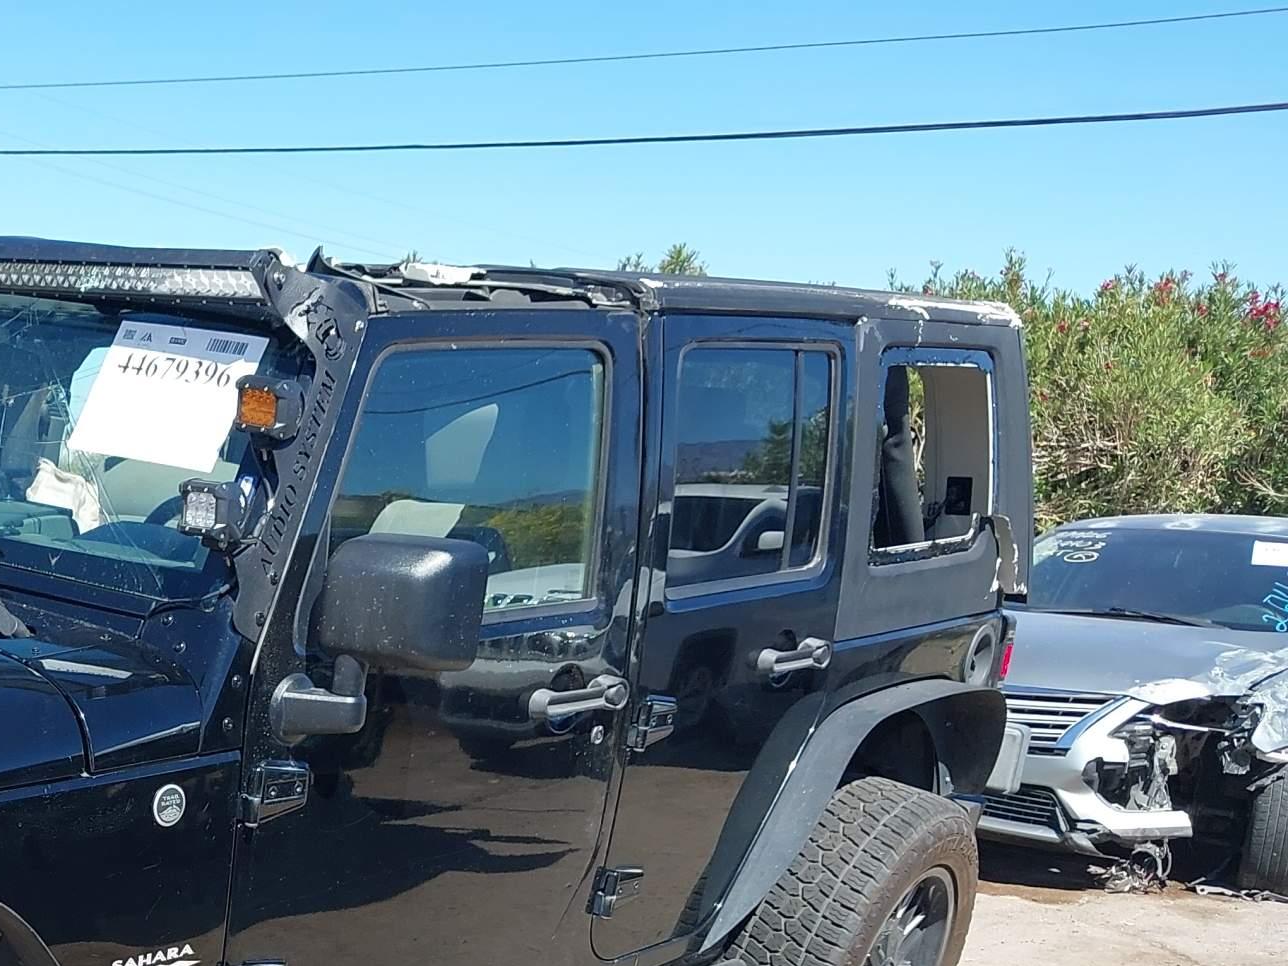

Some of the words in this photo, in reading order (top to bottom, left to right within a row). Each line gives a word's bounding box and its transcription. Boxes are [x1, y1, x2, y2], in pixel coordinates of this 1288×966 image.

[117, 353, 233, 387] 44679396
[261, 484, 297, 577] AUDIO
[293, 369, 337, 481] SYSTEM
